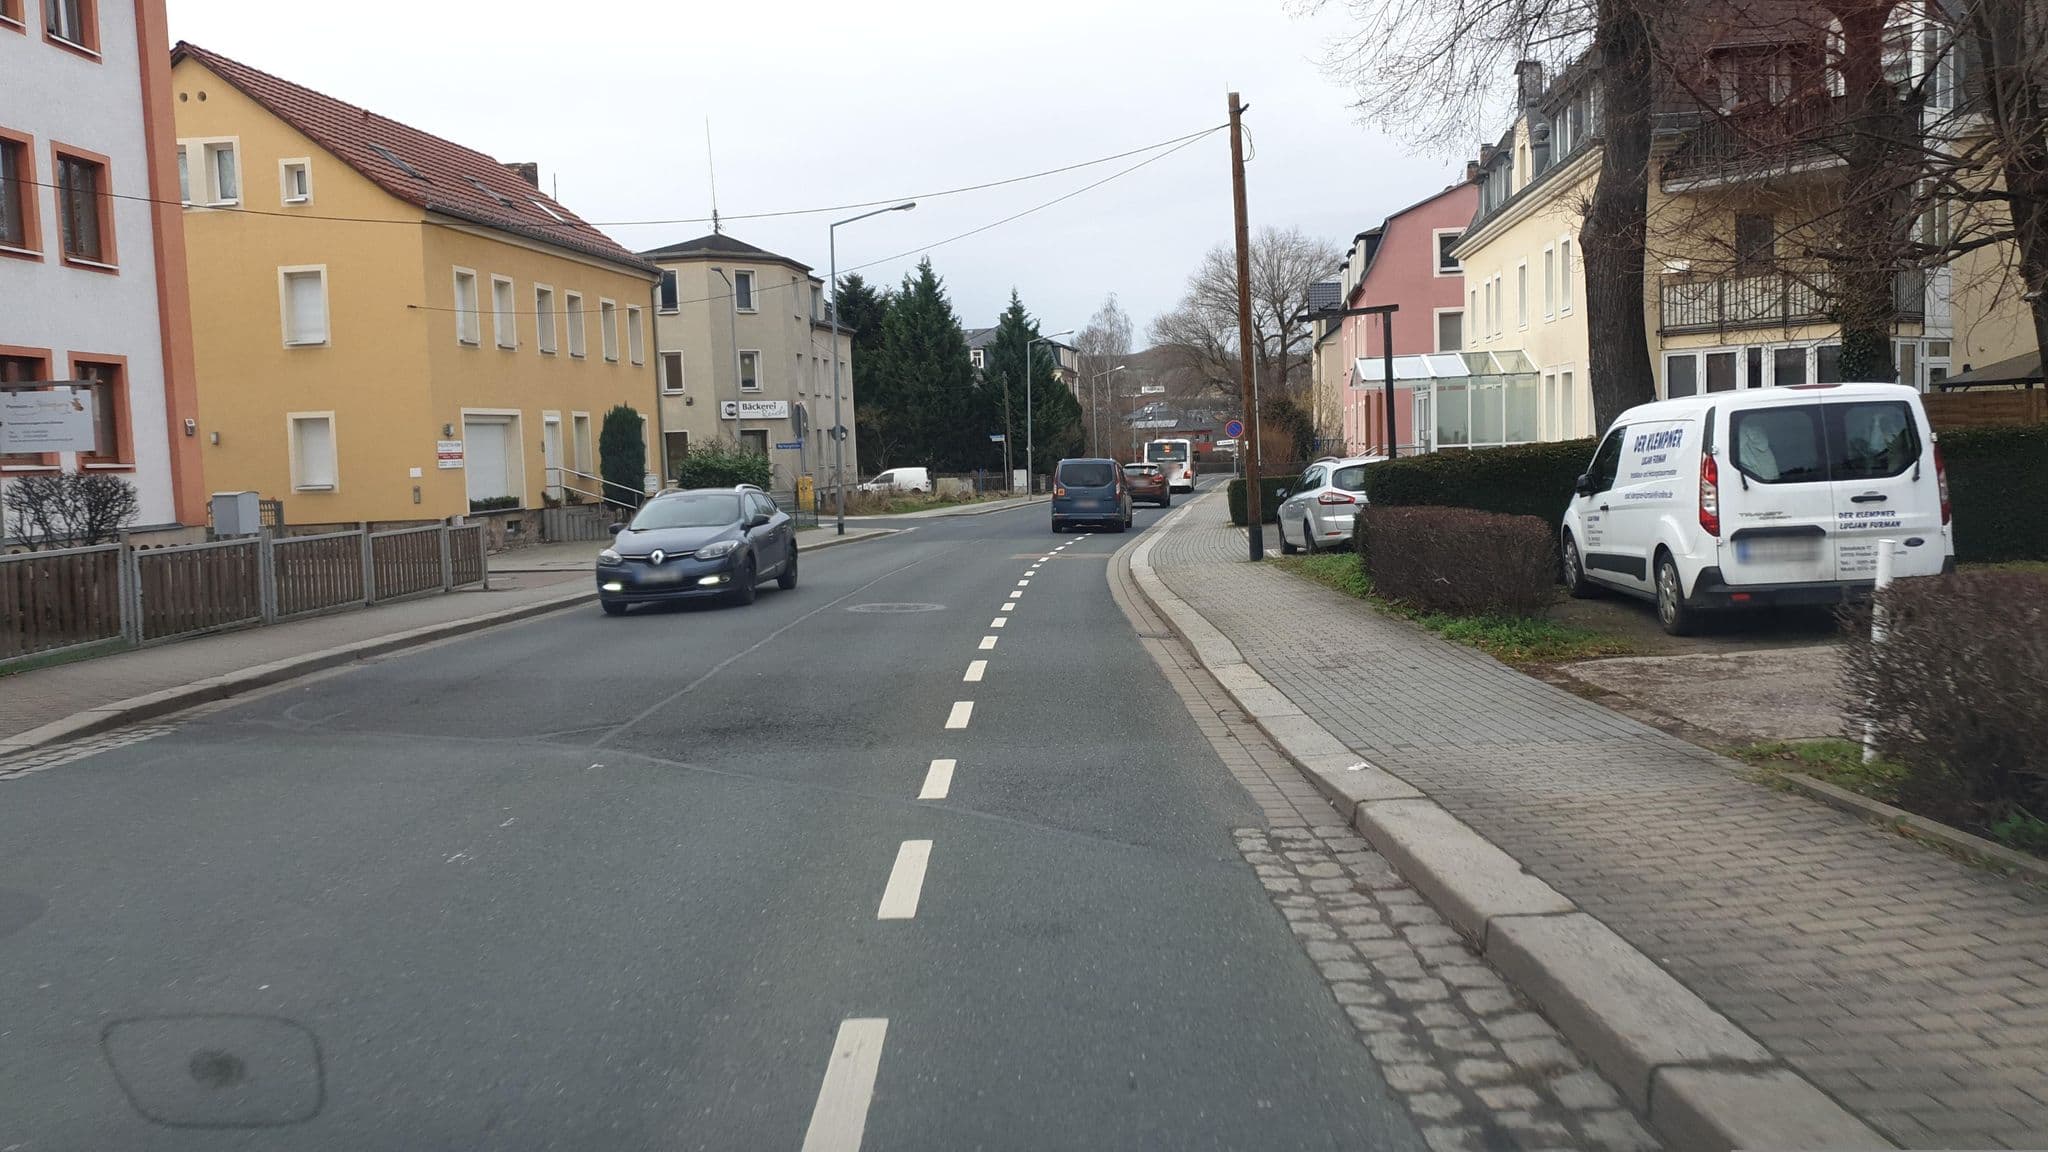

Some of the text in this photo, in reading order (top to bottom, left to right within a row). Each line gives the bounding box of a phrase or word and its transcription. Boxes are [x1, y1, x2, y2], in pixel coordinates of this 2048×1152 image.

[742, 402, 777, 411] Bäckerei
[1634, 429, 1683, 453] DER KLEMPNER
[1838, 511, 1896, 519] DER KLEMPNER
[1869, 520, 1902, 529] FURMAN
